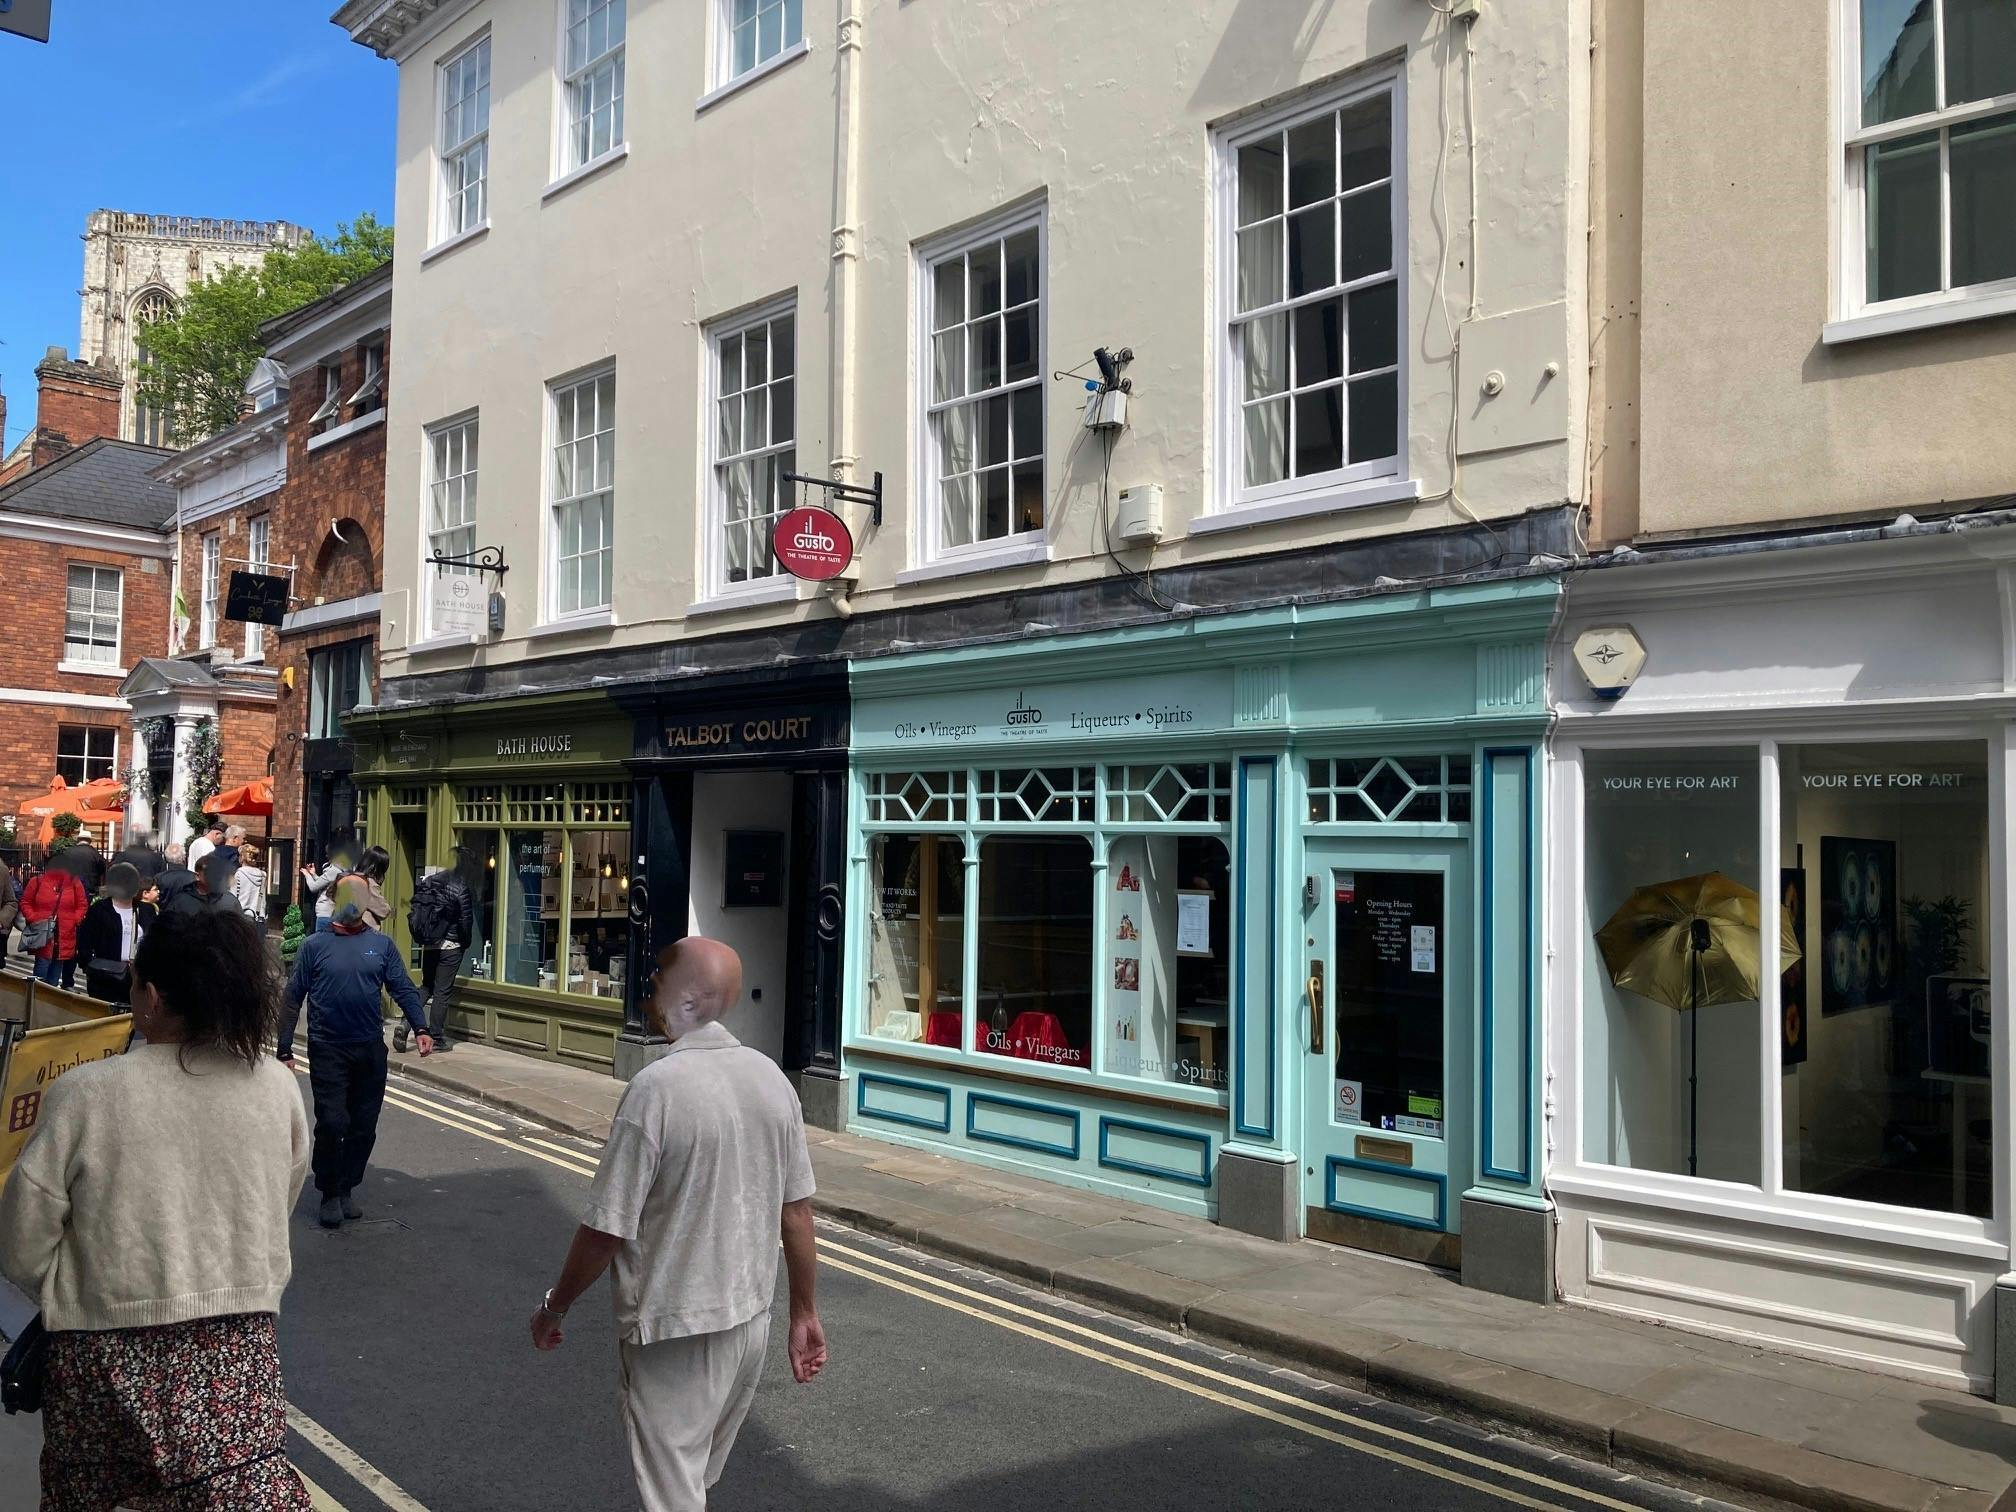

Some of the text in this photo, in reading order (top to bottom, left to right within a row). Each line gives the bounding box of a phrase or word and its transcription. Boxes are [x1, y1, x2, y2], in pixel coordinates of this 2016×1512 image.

[798, 553, 818, 561] THEATRE
[894, 705, 1193, 741] Oils Vinegars Liqueurs Spirits
[665, 717, 811, 748] TALBOT COURT
[497, 735, 572, 755] BATH HOUSE
[1603, 776, 1739, 789] YOUR EYE FOR ART
[1802, 773, 1964, 788] YOUR EYE FOR ART
[521, 844, 551, 854] the art of
[519, 863, 551, 876] perfumery
[1366, 899, 1413, 909] Opening Hours
[986, 1031, 1080, 1064] Oils Vinegars
[1180, 1058, 1229, 1085] Spirits
